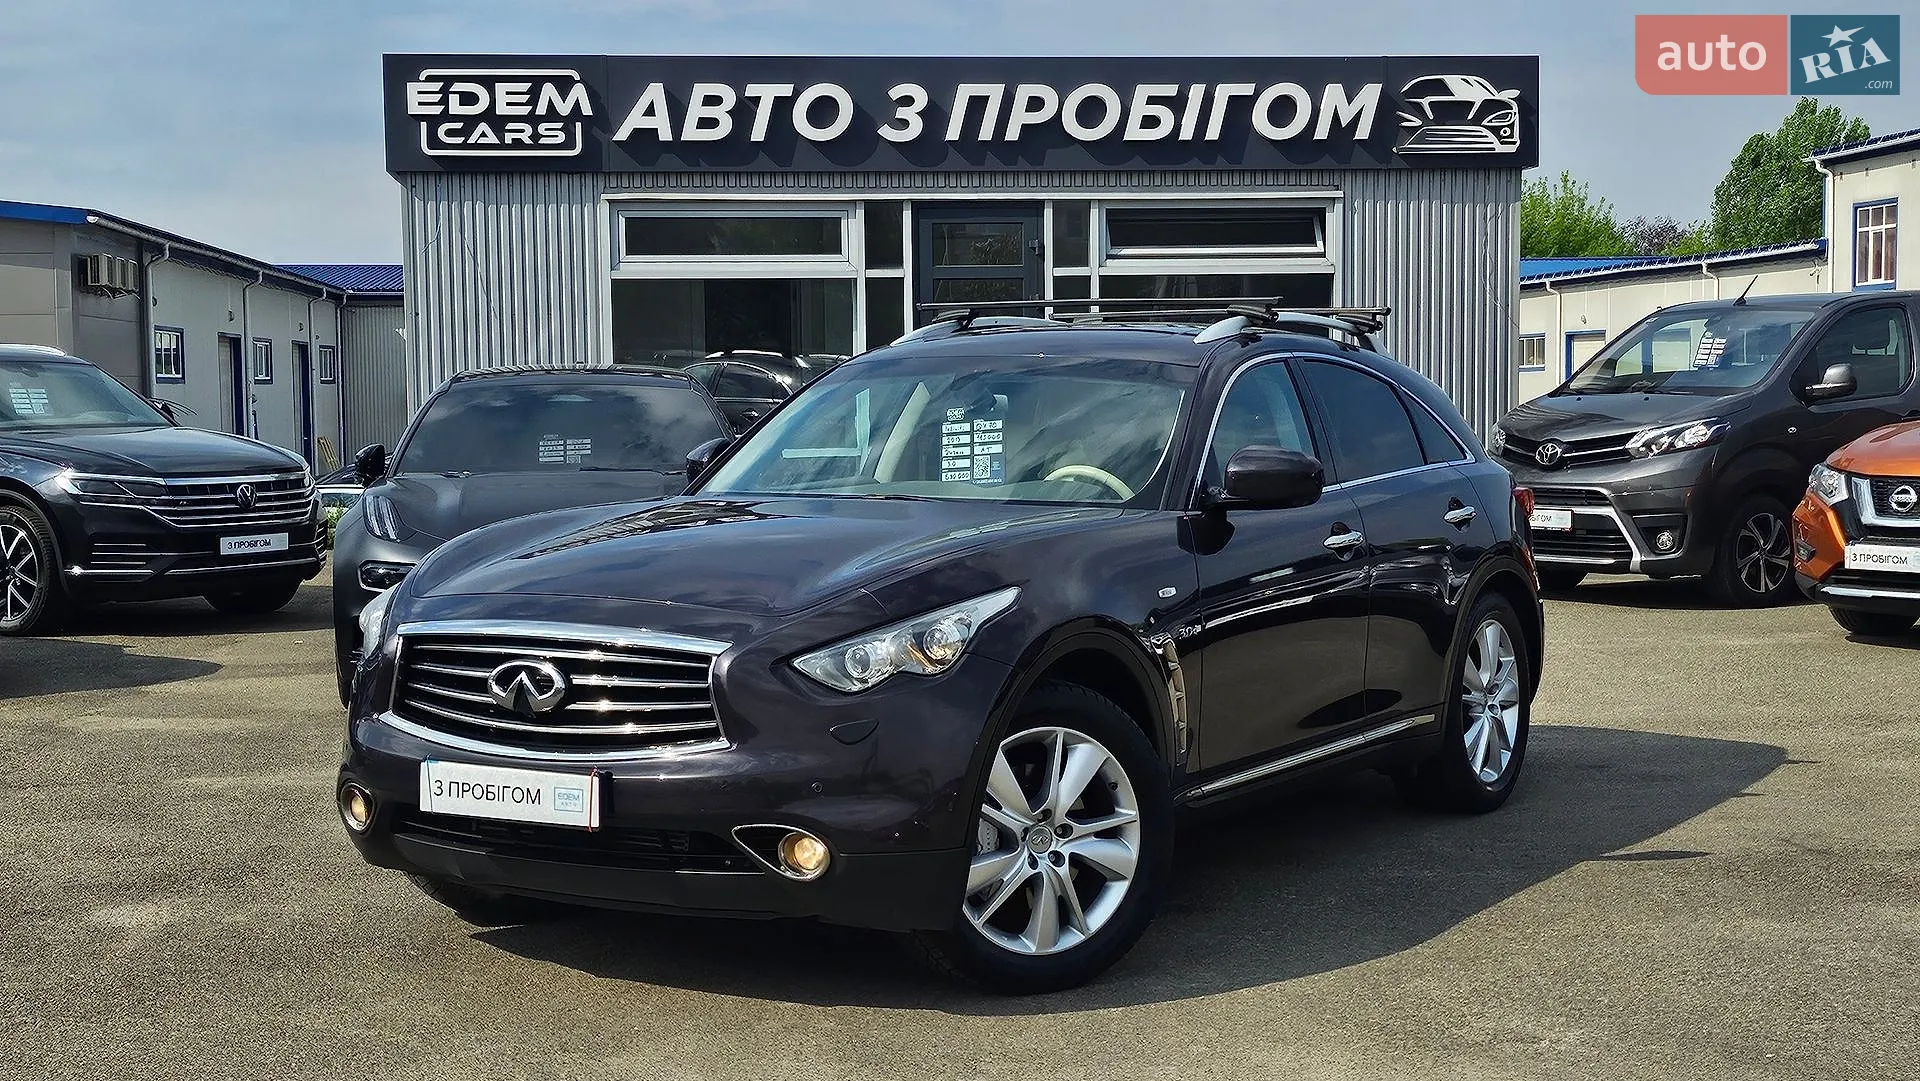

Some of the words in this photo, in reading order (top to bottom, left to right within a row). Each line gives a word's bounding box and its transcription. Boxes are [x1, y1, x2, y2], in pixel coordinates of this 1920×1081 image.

[407, 82, 594, 116] EDEM
[612, 82, 855, 143] АВТО
[877, 82, 929, 143] З
[944, 82, 1383, 143] ПРОБІГОМ
[437, 122, 567, 145] CARS
[1859, 553, 1908, 565] ПРОБІГОМ
[433, 779, 444, 797] З
[448, 781, 542, 806] ПРОБІГОМ
